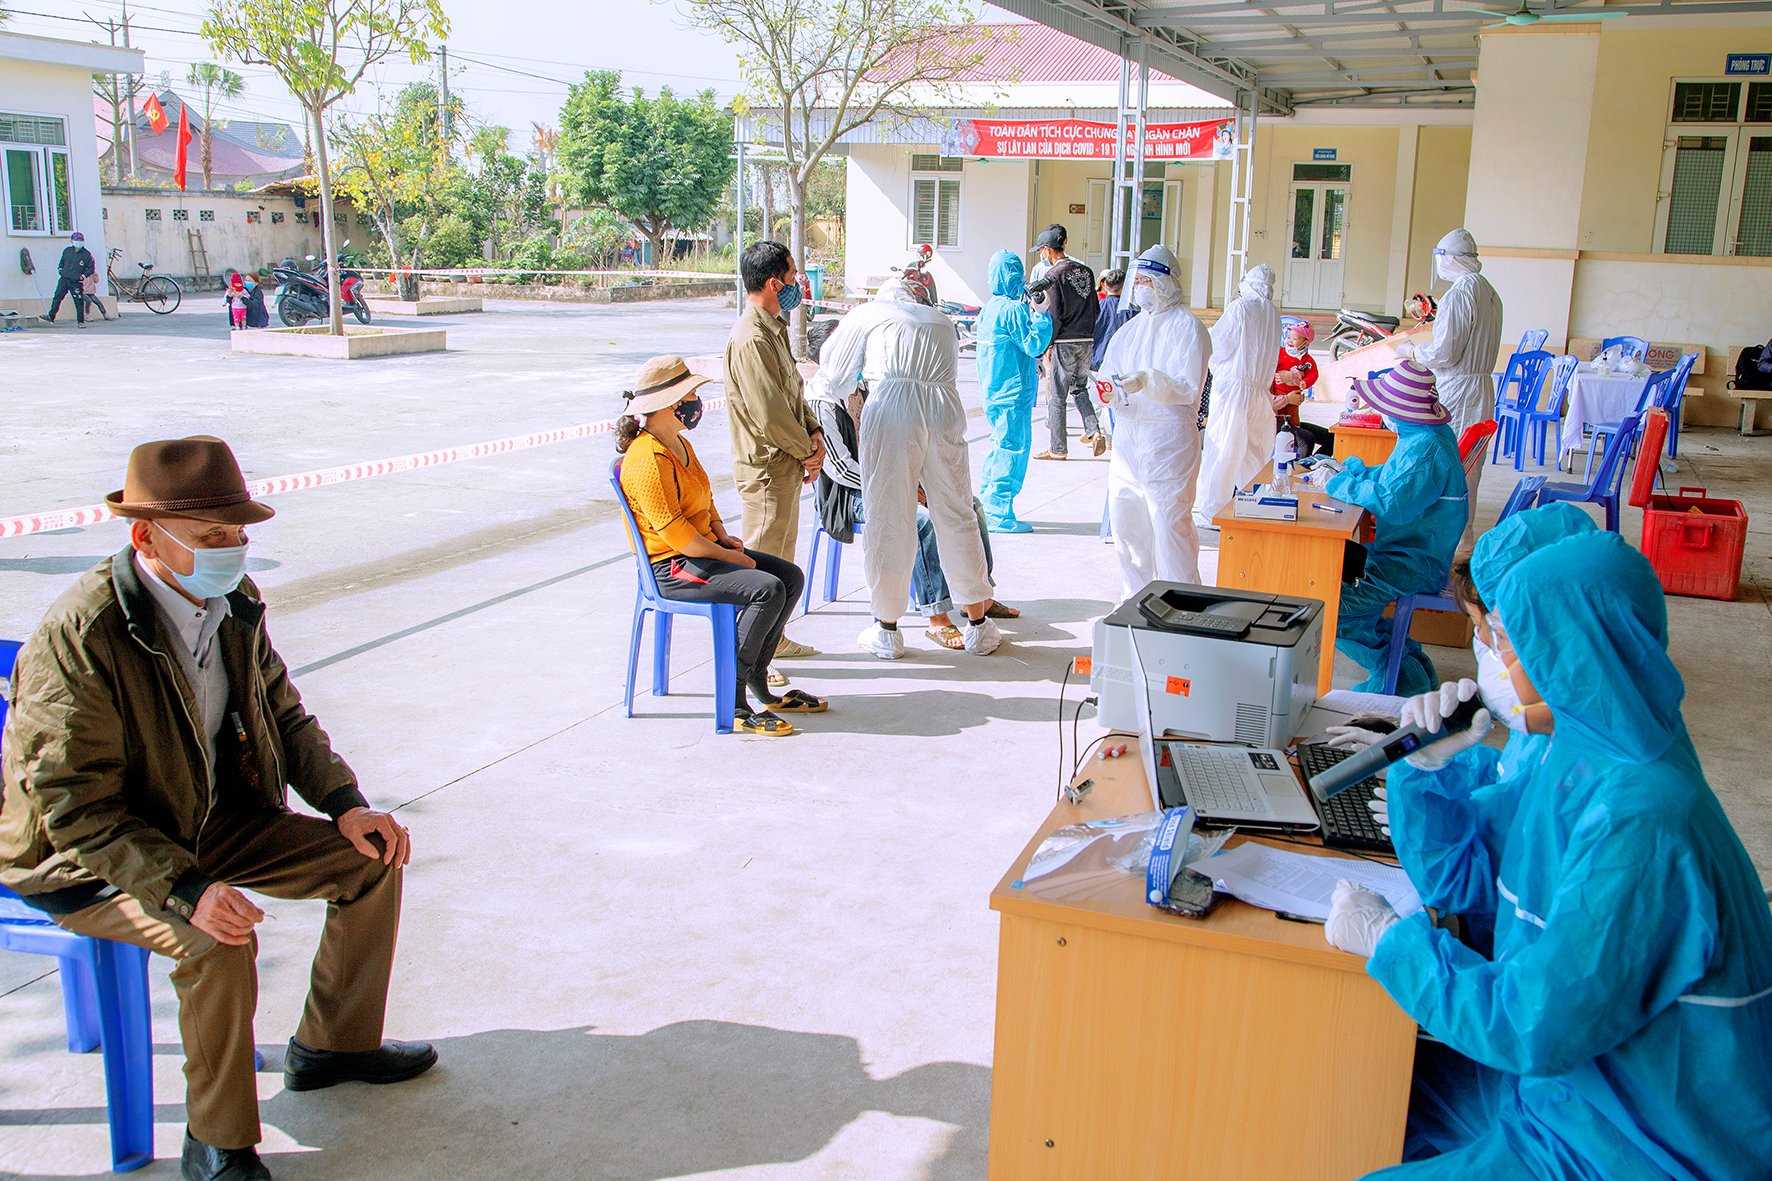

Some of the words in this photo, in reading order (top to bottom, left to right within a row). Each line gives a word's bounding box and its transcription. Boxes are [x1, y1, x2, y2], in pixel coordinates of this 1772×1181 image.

[989, 124, 1016, 137] TOÀN
[1017, 124, 1038, 137] DÂN
[1040, 124, 1061, 138] TÍCH
[1063, 125, 1083, 140] CỰC
[997, 140, 1008, 156] SỰ
[1008, 139, 1021, 154] LÂY
[1023, 141, 1037, 154] LAN
[1038, 138, 1053, 154] CỦA
[1054, 142, 1071, 157] DỊCH
[1073, 142, 1094, 155] COVID
[1101, 143, 1110, 156] 19
[1155, 141, 1174, 155] HÌNH
